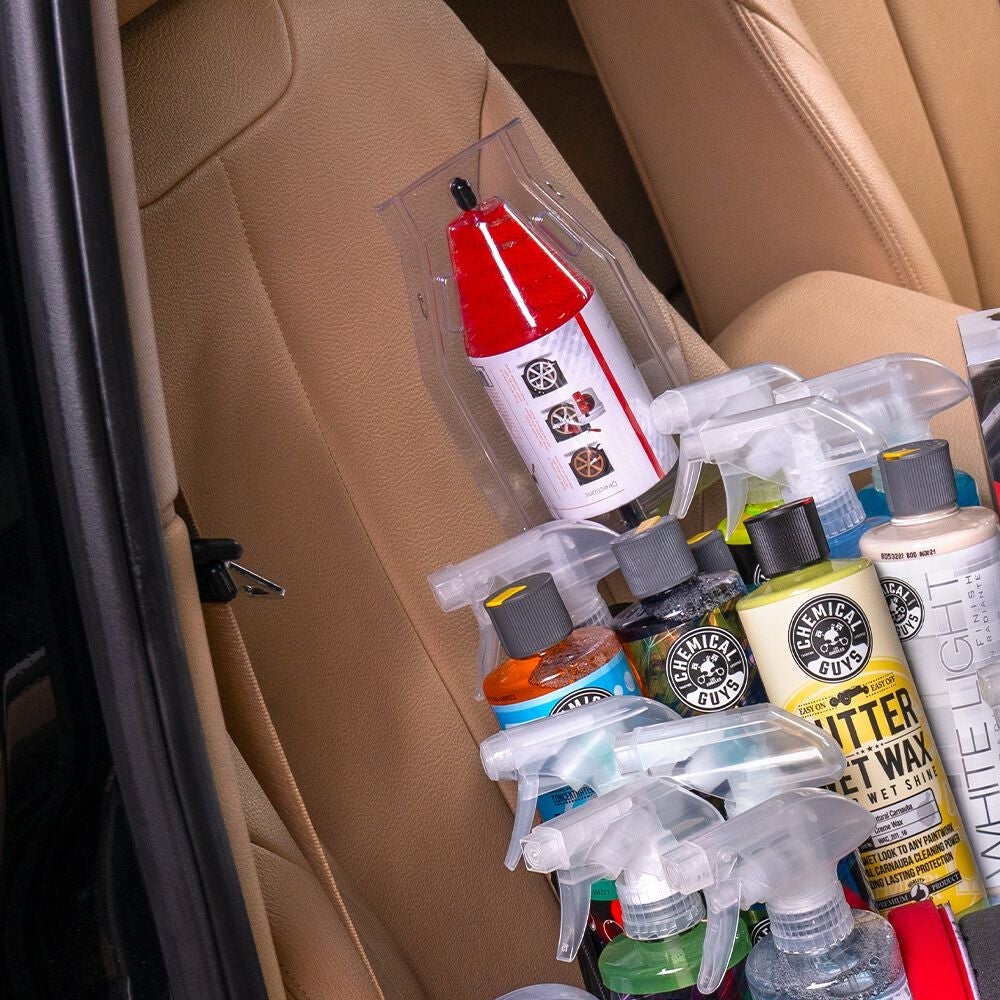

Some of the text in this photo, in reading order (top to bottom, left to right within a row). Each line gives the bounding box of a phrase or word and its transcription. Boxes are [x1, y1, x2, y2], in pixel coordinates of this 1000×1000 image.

[796, 601, 863, 650] CHEMICAL
[964, 575, 985, 647] FINISH
[974, 573, 993, 643] RADIANTE
[672, 634, 737, 683] CHEMICAL
[924, 572, 983, 710] LIGHT
[819, 649, 863, 676] GUYS
[698, 679, 740, 706] GUYS
[798, 675, 897, 716] EASY ON EASY OFF
[814, 687, 920, 750] UTTER
[875, 731, 934, 782] WAX
[867, 766, 939, 804] WET SHINE
[879, 848, 898, 862] LOOK
[900, 845, 909, 855] TO
[909, 839, 924, 852] ANY
[923, 823, 955, 846] PAINTWORK
[890, 820, 904, 829] Wax
[869, 877, 886, 890] ONG
[886, 869, 915, 886] LASTING
[916, 852, 955, 876] PROTECTION
[875, 855, 915, 876] CARNAUBA
[914, 845, 945, 863] CLEANING
[945, 832, 961, 850] POWER
[931, 873, 960, 891] PRODUCT
